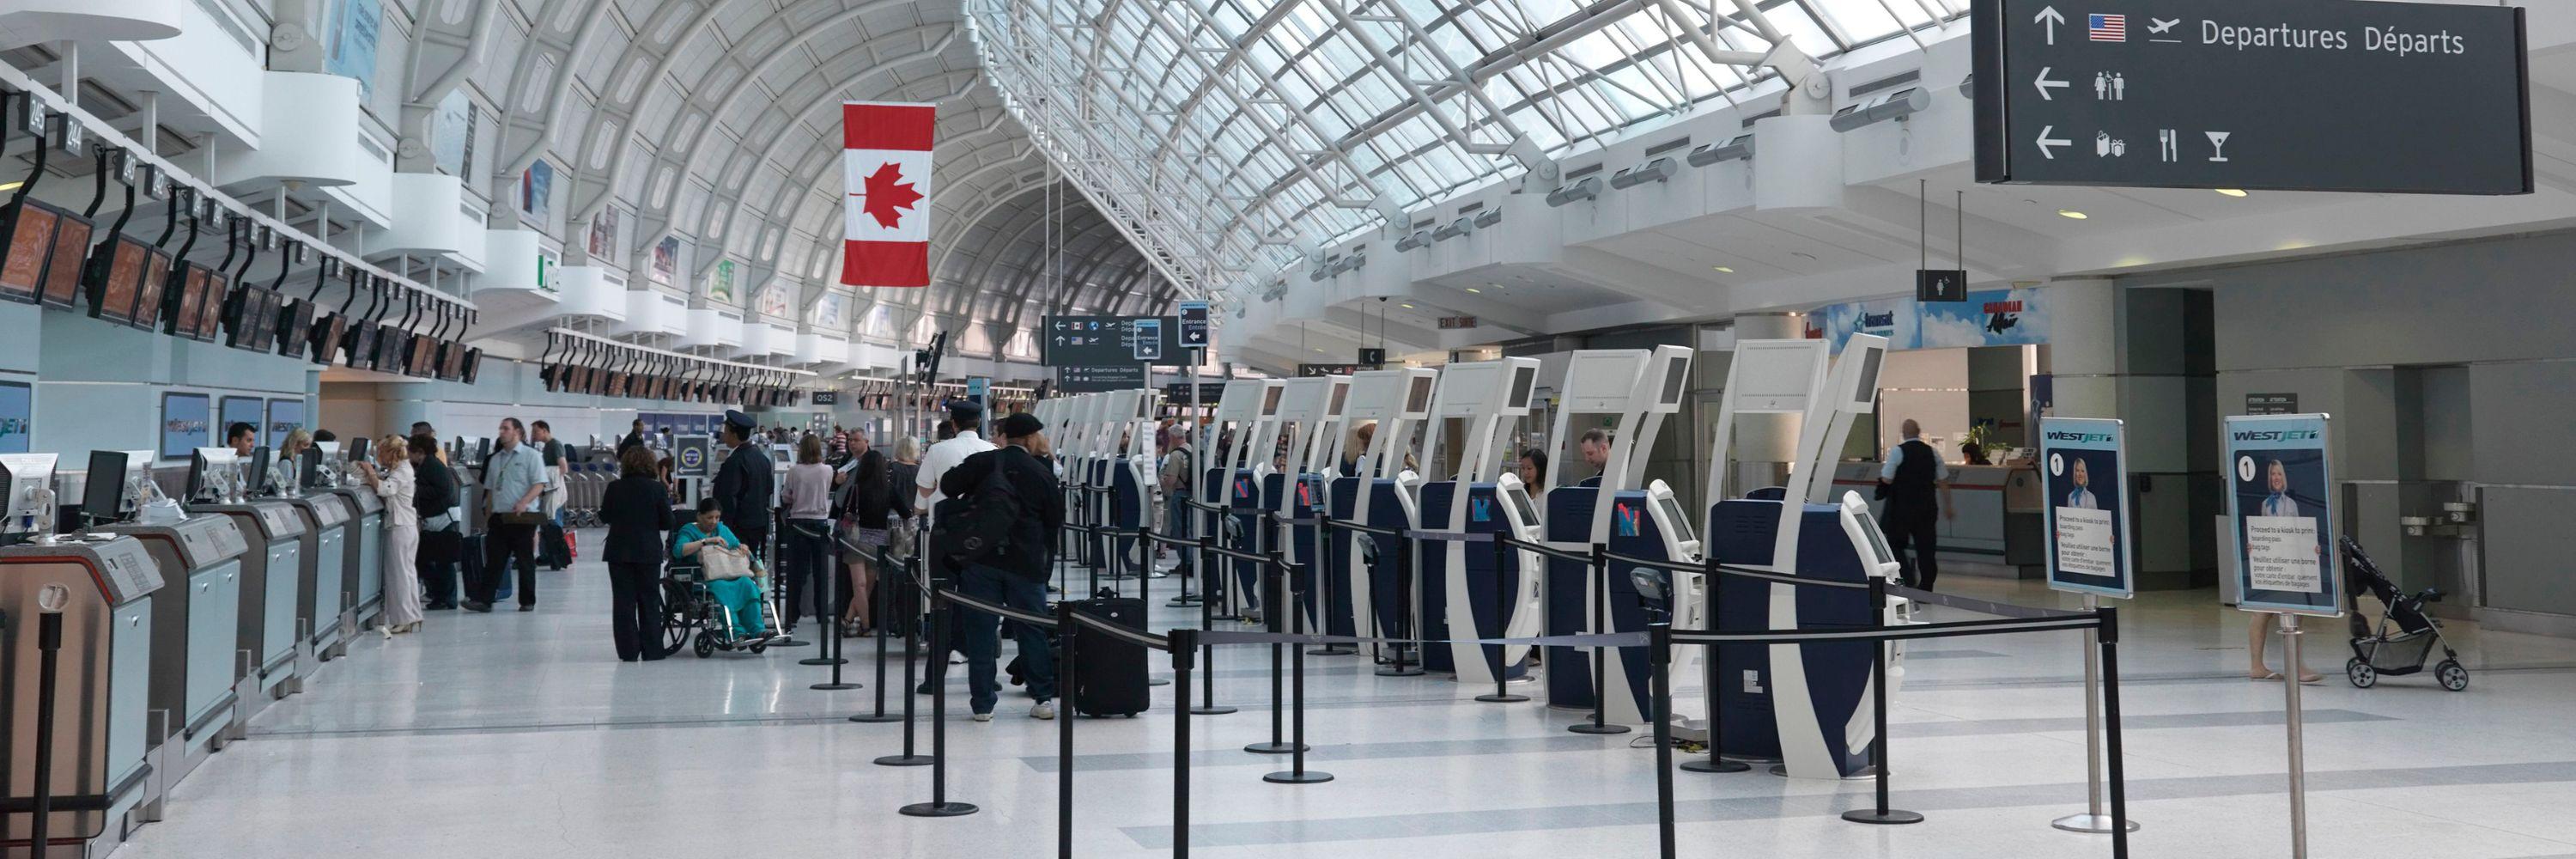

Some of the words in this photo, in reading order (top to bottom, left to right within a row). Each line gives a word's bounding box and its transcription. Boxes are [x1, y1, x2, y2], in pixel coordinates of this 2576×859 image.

[2202, 19, 2348, 51] Departures
[2364, 26, 2464, 57] Départs
[30, 99, 45, 131] 245
[67, 121, 82, 150] 244
[124, 155, 137, 180] 243
[1984, 301, 2022, 314] CANADIAN
[1440, 317, 1455, 328] EXIT
[1864, 310, 1893, 327] transat
[1986, 313, 2019, 335] Affair
[2047, 431, 2106, 443] WESTJET
[2234, 430, 2310, 442] WESTJET
